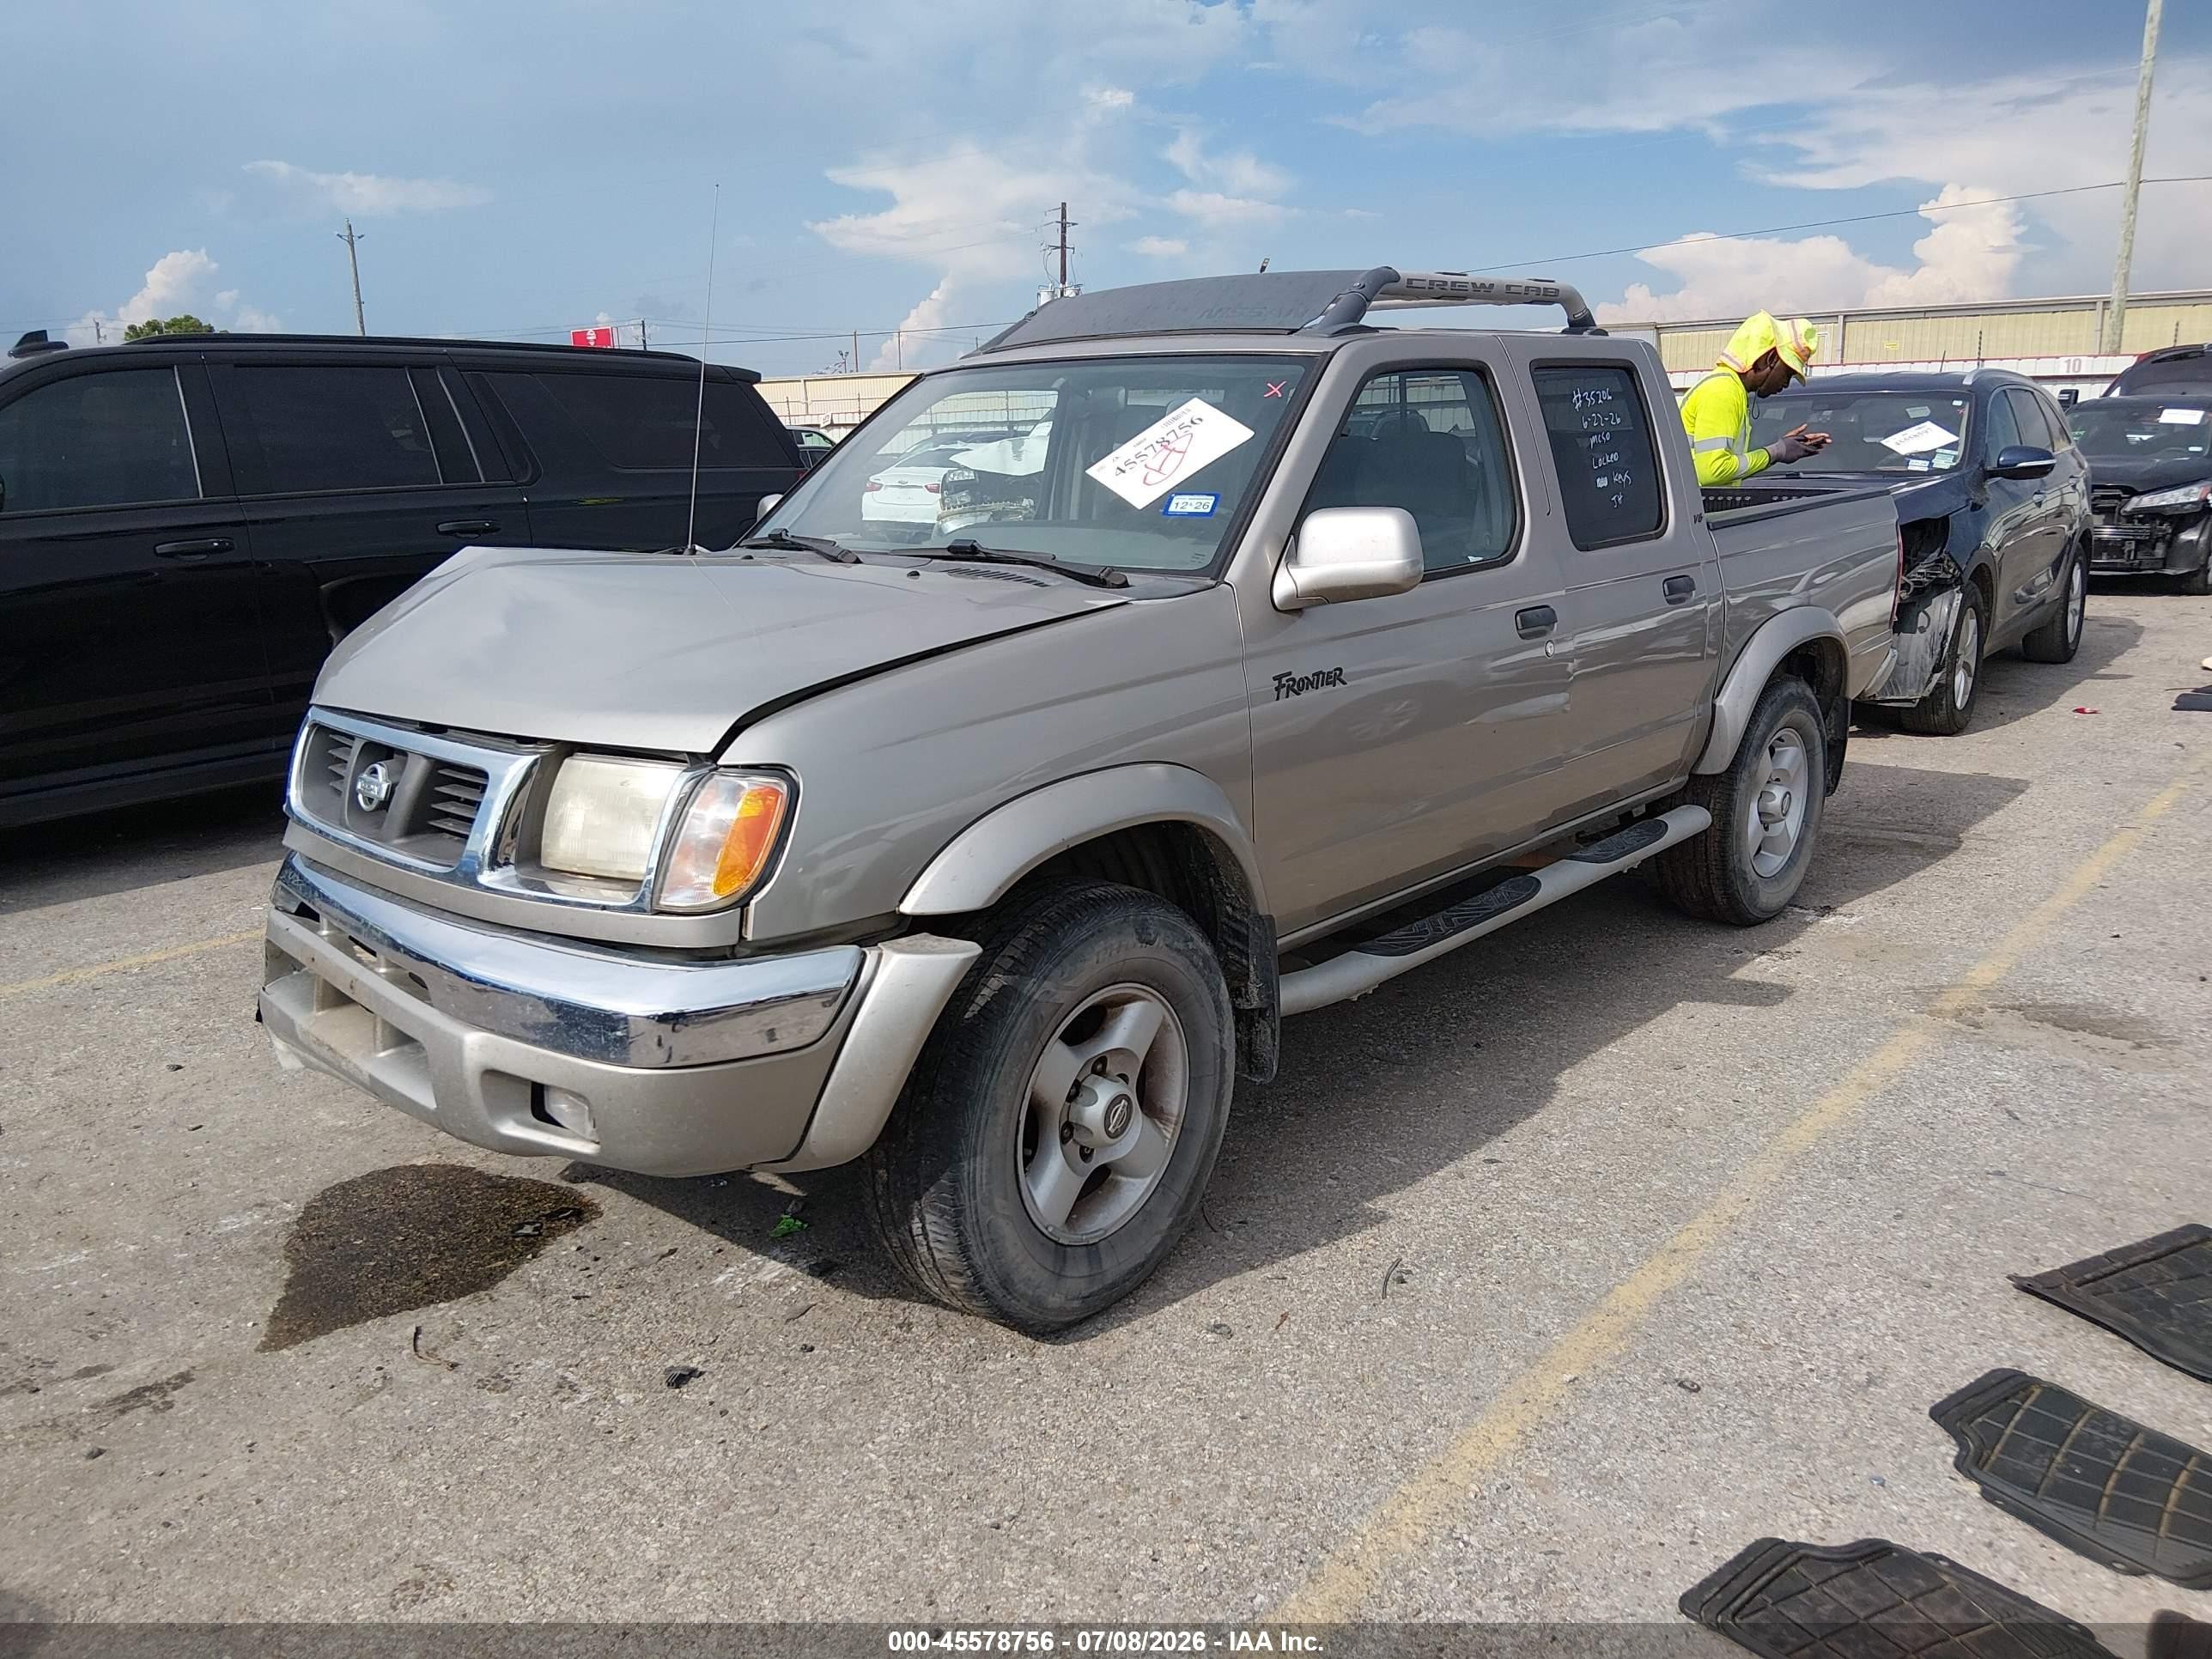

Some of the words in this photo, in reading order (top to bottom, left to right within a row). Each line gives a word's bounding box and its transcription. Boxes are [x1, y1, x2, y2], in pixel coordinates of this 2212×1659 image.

[1406, 277, 1494, 293] CREW
[1505, 284, 1559, 297] CAB
[2063, 358, 2081, 374] 10
[1582, 412, 1621, 429] 6-22-26
[1115, 415, 1203, 477] 45578756
[1174, 501, 1189, 510] 12
[1194, 501, 1211, 510] 26
